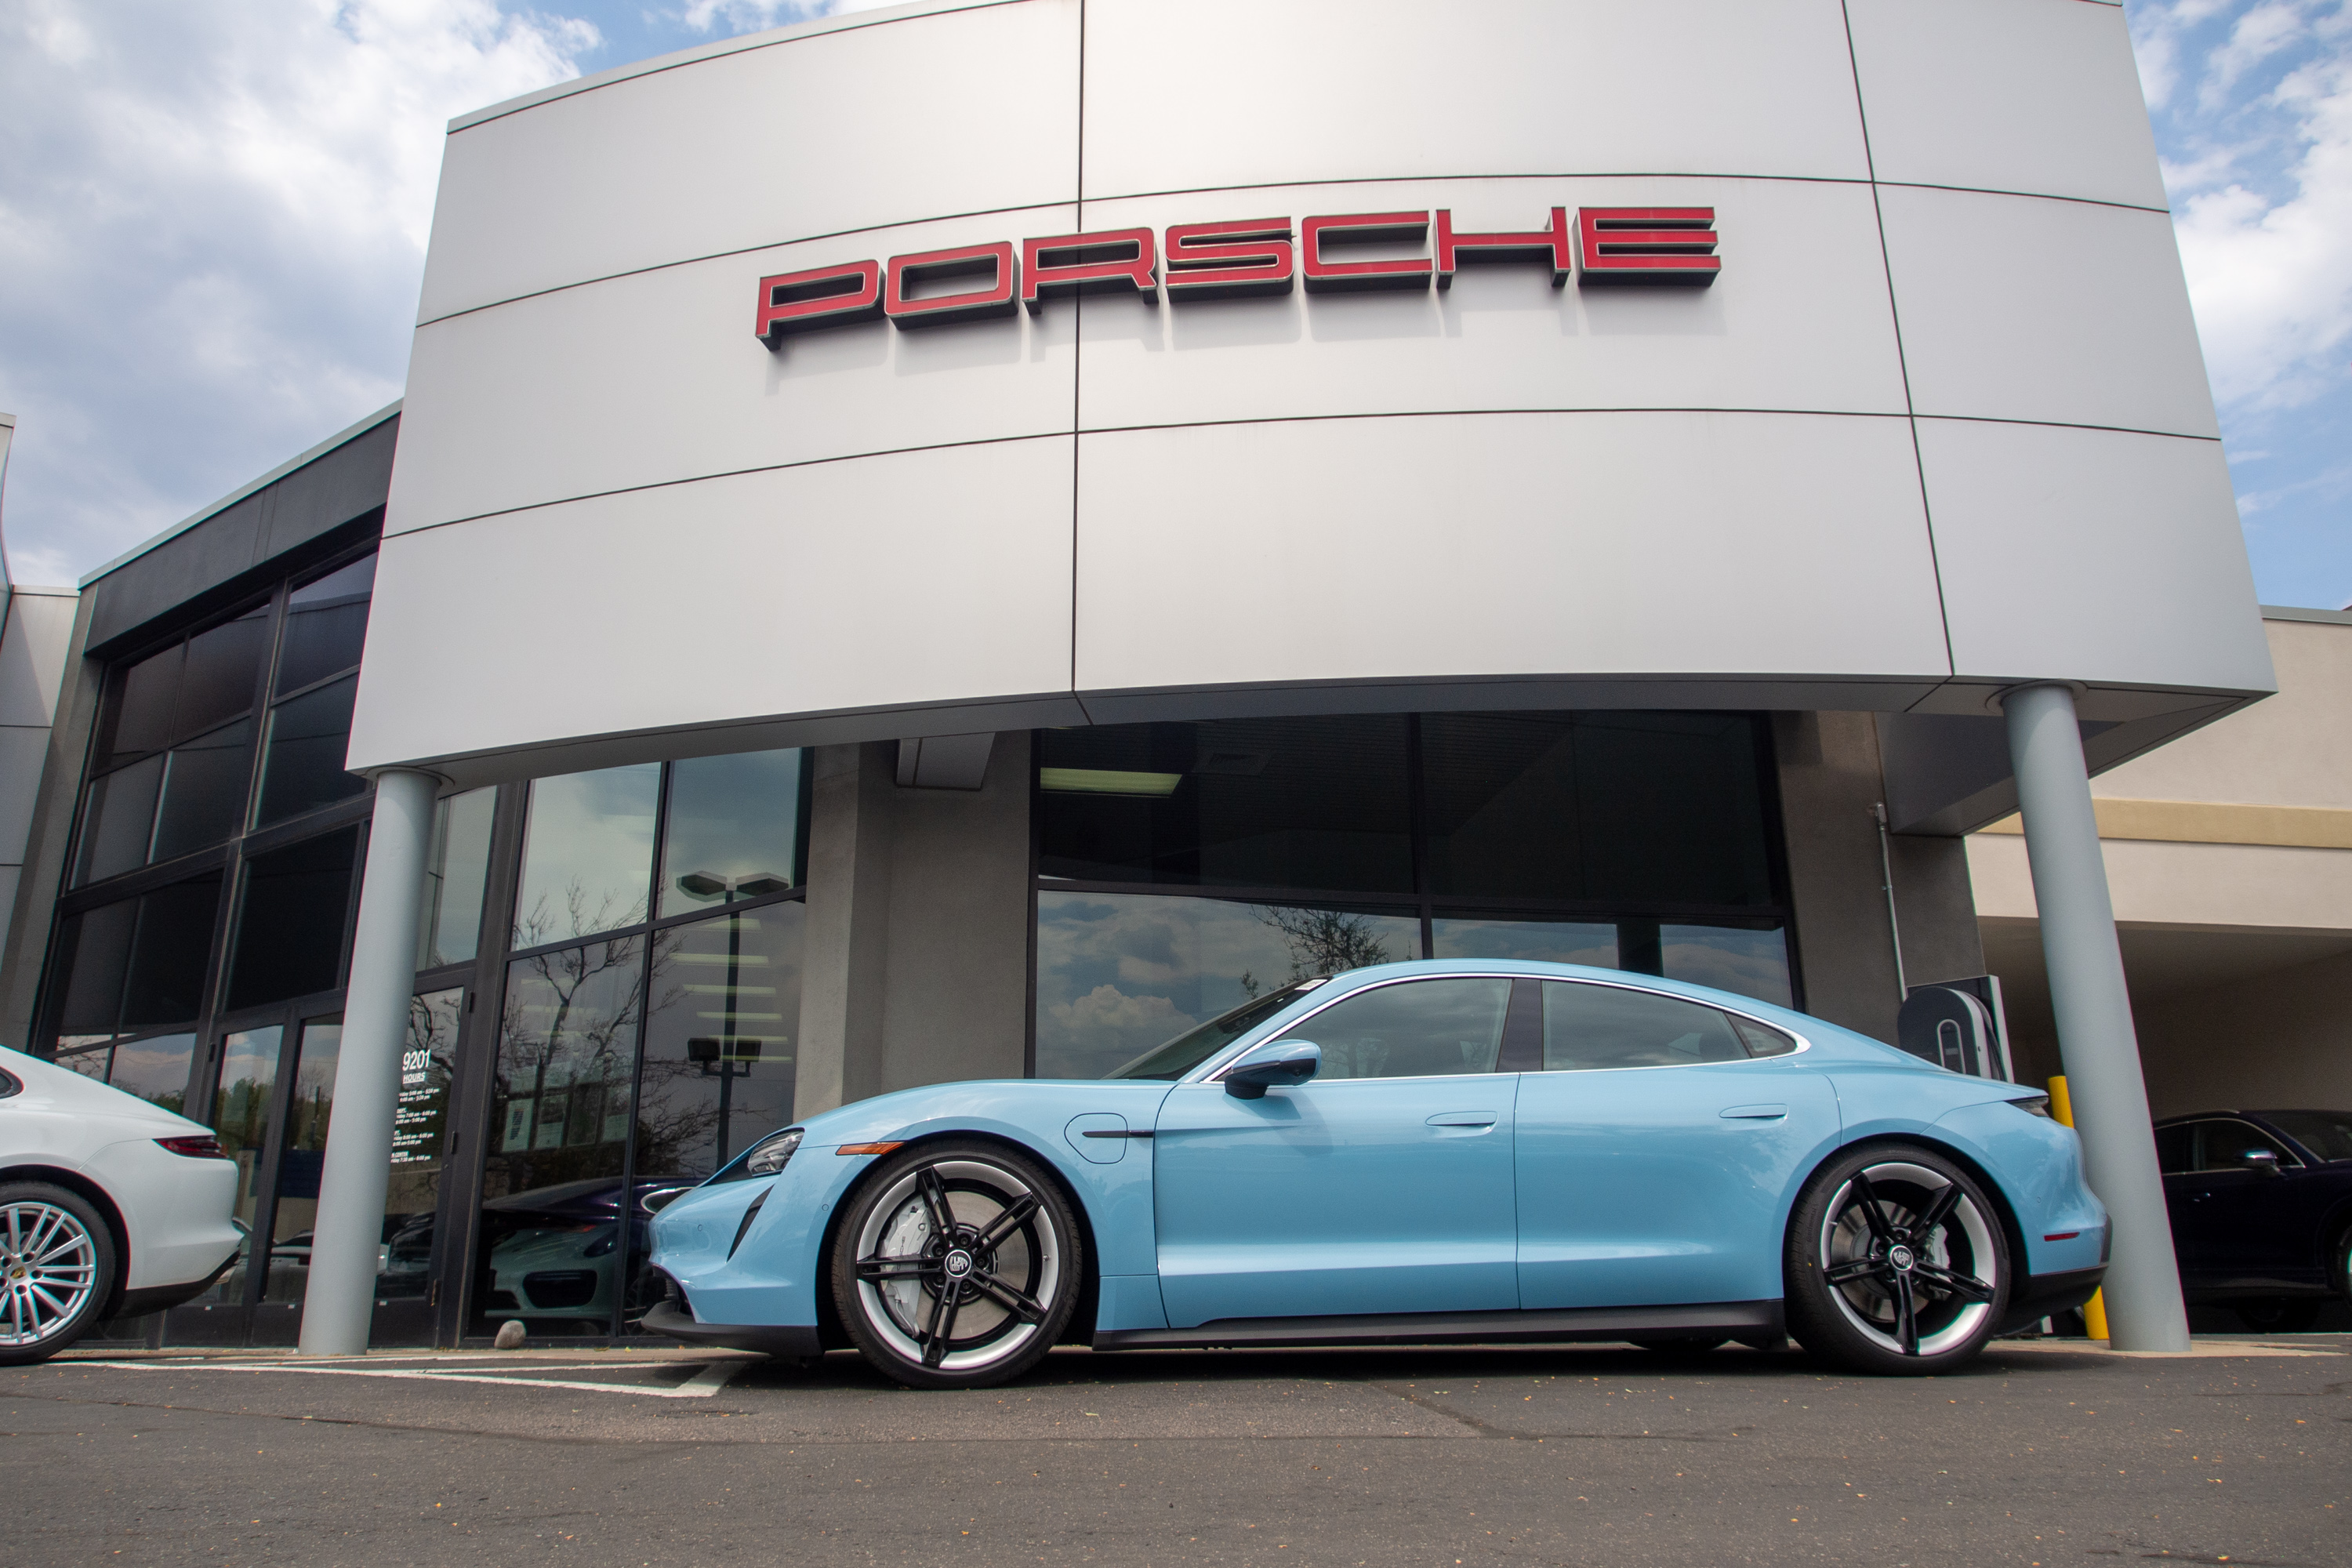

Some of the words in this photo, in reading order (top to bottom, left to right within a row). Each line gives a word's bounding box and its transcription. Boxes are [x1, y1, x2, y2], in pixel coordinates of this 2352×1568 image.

[756, 205, 1721, 350] PORSCHE
[402, 1049, 430, 1071] 9201
[402, 1072, 426, 1083] HOURS
